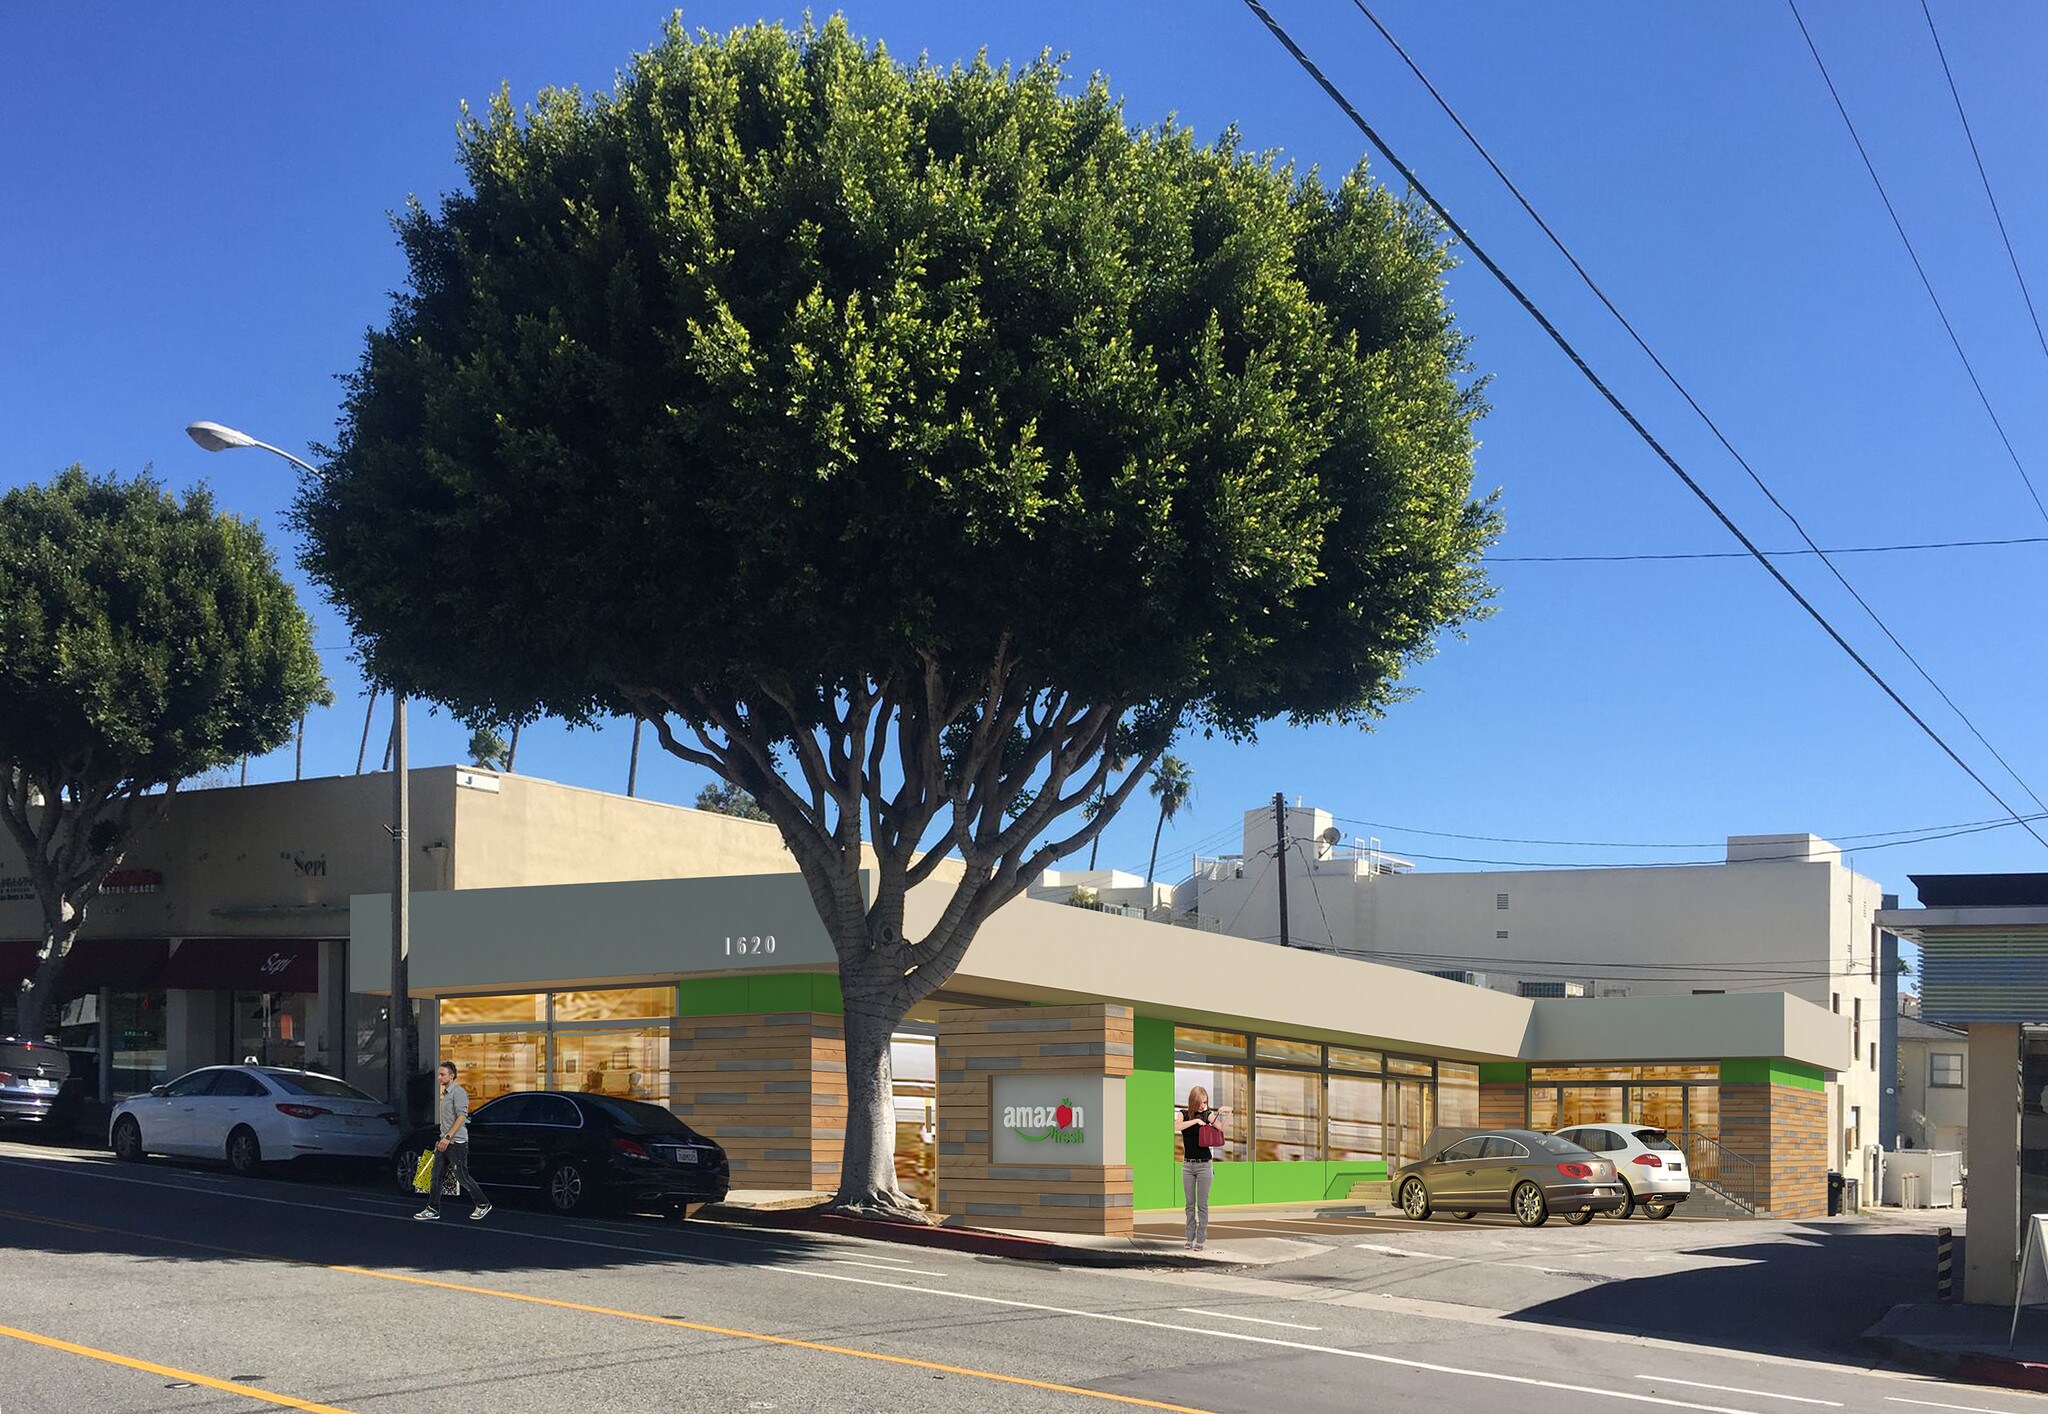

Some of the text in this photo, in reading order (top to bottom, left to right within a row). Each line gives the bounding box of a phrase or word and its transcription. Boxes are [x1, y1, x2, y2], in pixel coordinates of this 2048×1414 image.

[725, 935, 776, 956] 1620
[1003, 1104, 1085, 1129] amazon
[1053, 1129, 1085, 1144] fresh
